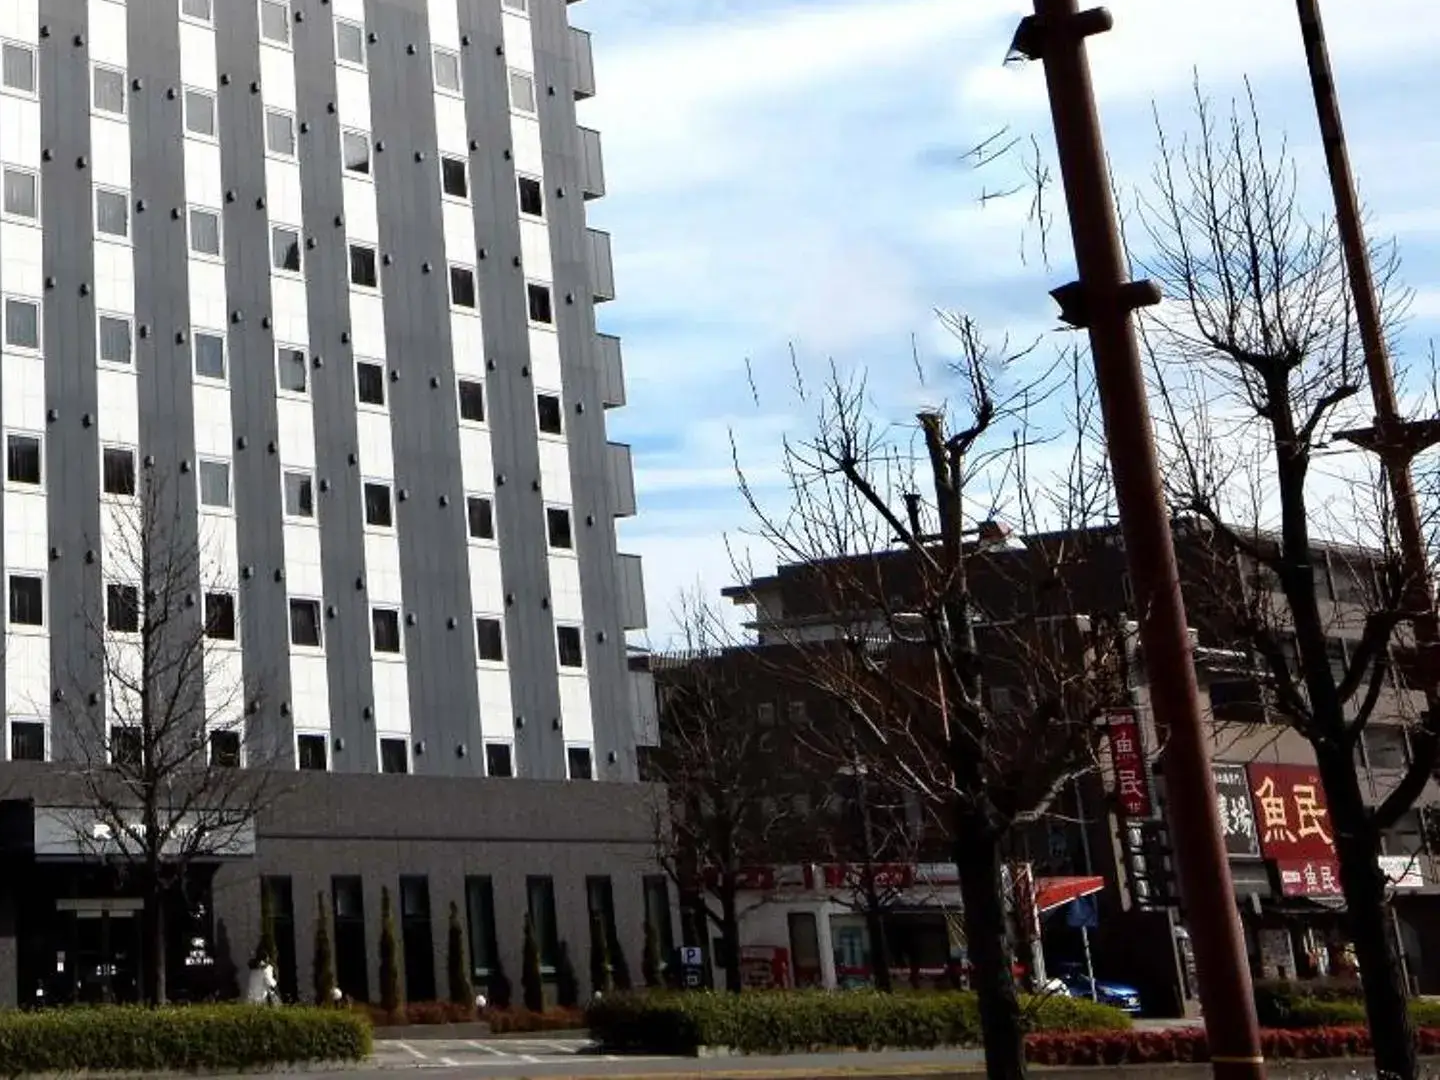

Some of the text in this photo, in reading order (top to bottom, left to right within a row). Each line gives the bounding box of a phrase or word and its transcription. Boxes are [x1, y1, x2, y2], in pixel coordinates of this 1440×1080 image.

[1255, 776, 1334, 844] 魚民
[1303, 863, 1341, 893] 魚民
[686, 949, 696, 963] P
